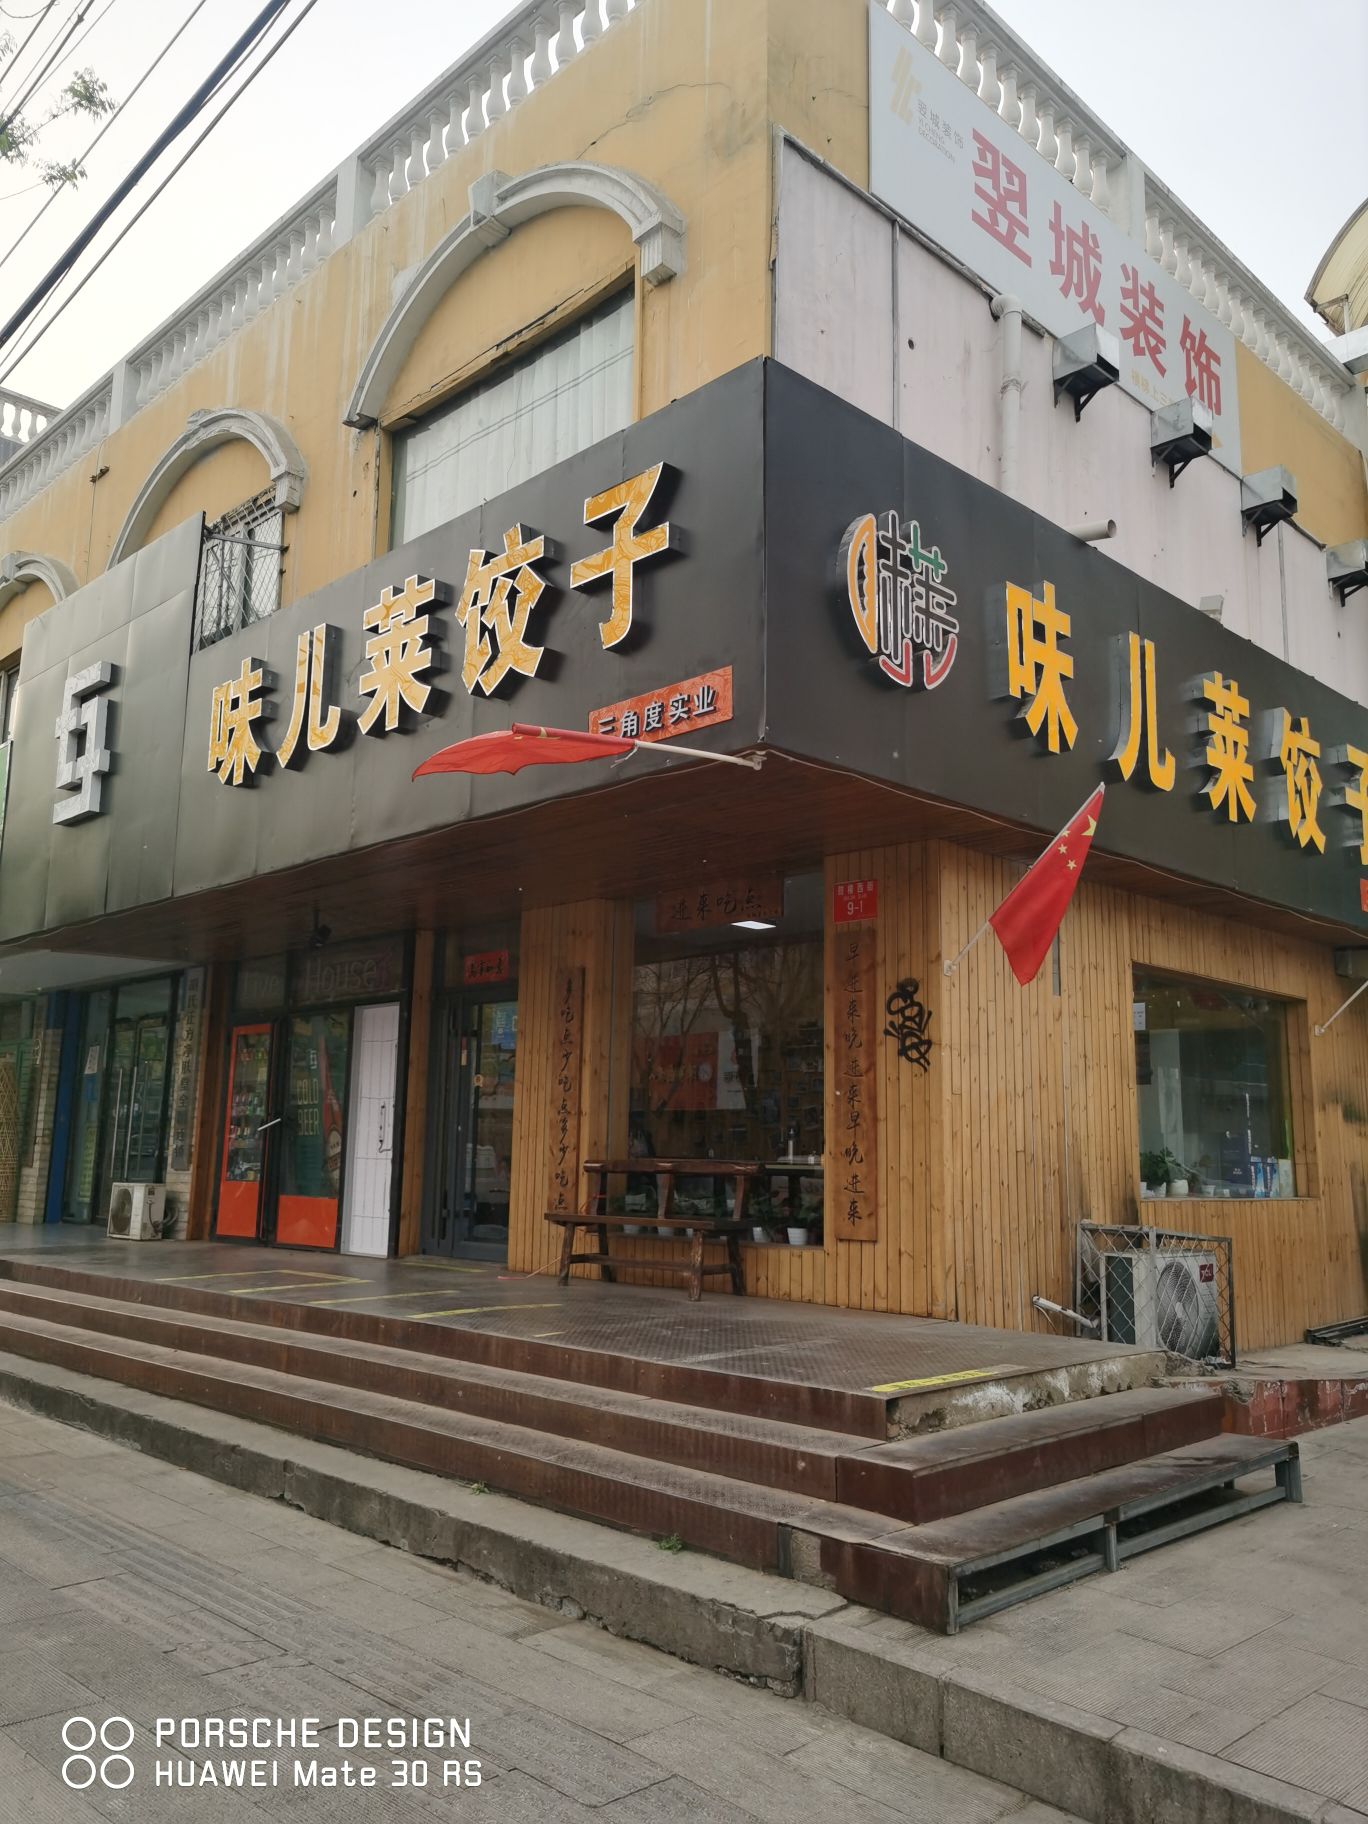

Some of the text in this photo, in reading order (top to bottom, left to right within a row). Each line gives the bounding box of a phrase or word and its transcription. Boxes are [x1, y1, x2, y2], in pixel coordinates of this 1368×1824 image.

[971, 127, 1223, 417] 翌城装饰
[598, 685, 717, 738] 三角度实业
[305, 959, 377, 993] House
[296, 1079, 319, 1104] COLD
